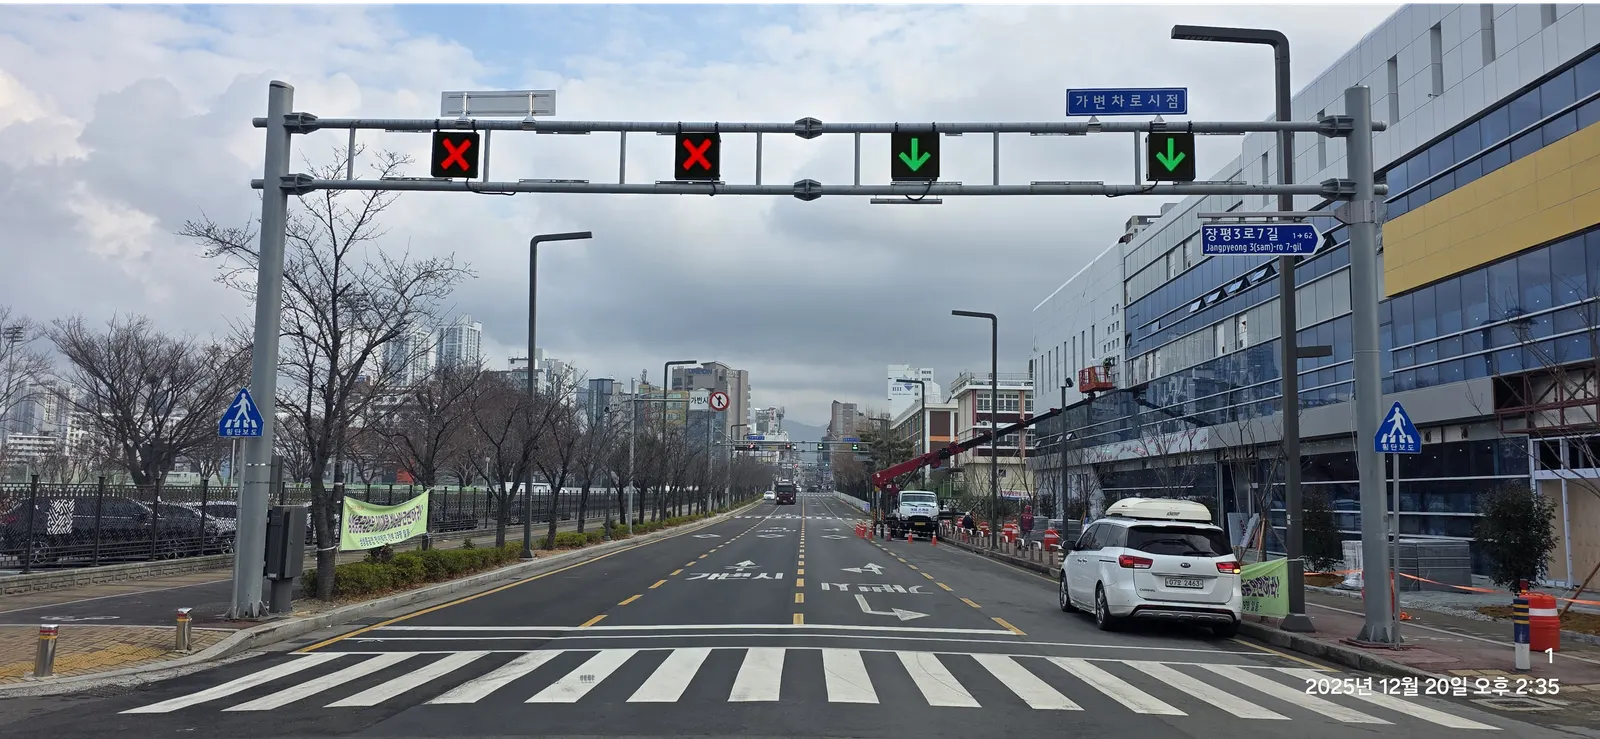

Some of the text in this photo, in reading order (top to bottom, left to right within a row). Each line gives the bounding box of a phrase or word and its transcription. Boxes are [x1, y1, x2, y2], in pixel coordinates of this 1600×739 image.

[1076, 94, 1178, 109] 가변차로시점
[1205, 227, 1279, 242] 장평3로7길
[1206, 243, 1302, 253] Jangpyeong 3(sam)-ro 7-gil
[1382, 443, 1415, 451] 횡단보도
[685, 572, 784, 581] 가변시
